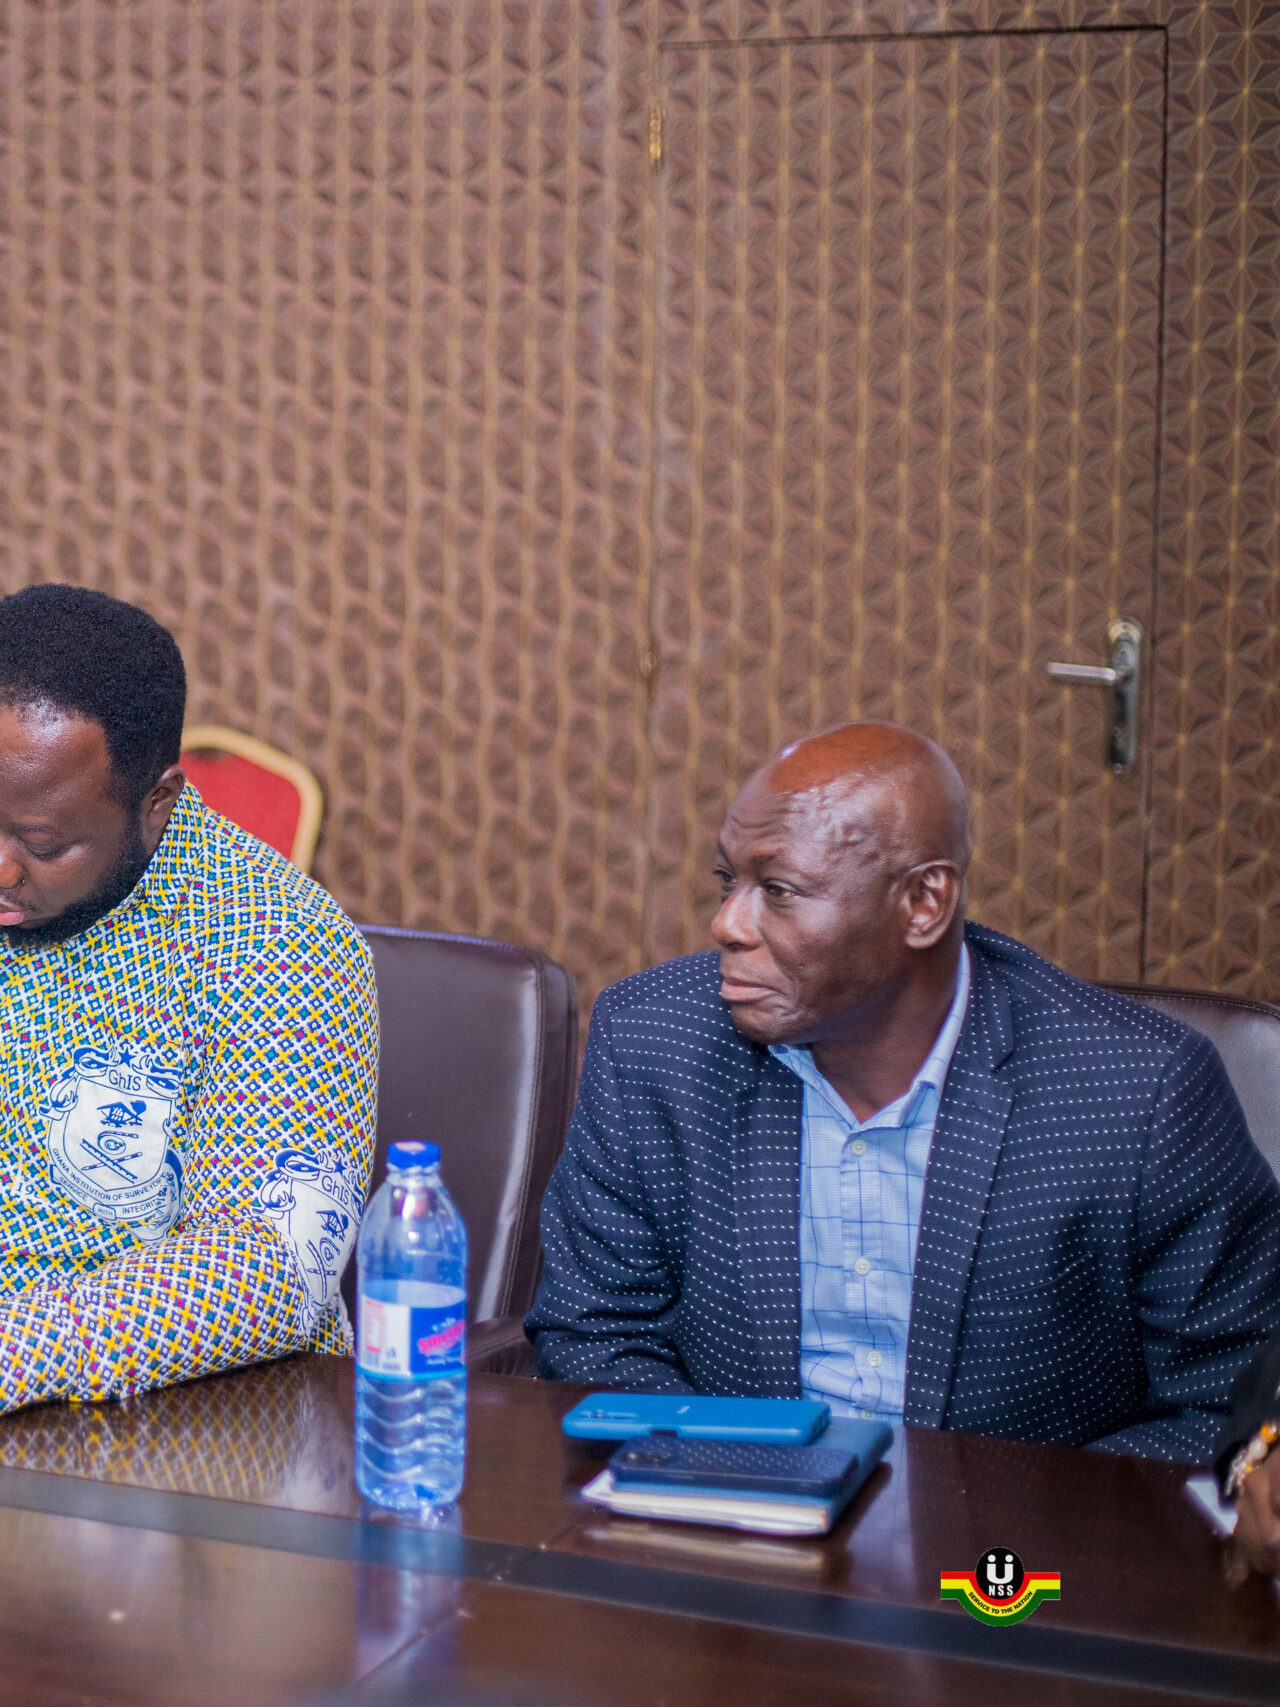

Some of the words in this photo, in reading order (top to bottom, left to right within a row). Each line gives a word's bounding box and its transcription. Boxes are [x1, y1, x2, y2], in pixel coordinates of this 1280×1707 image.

[108, 1069, 142, 1092] GhIS
[52, 1147, 70, 1173] GHANA
[70, 1172, 111, 1201] INSTITUTION
[112, 1193, 123, 1201] OF
[60, 1176, 88, 1201] SERVICE
[321, 1175, 350, 1205] GhIS
[97, 1208, 114, 1216] WITH
